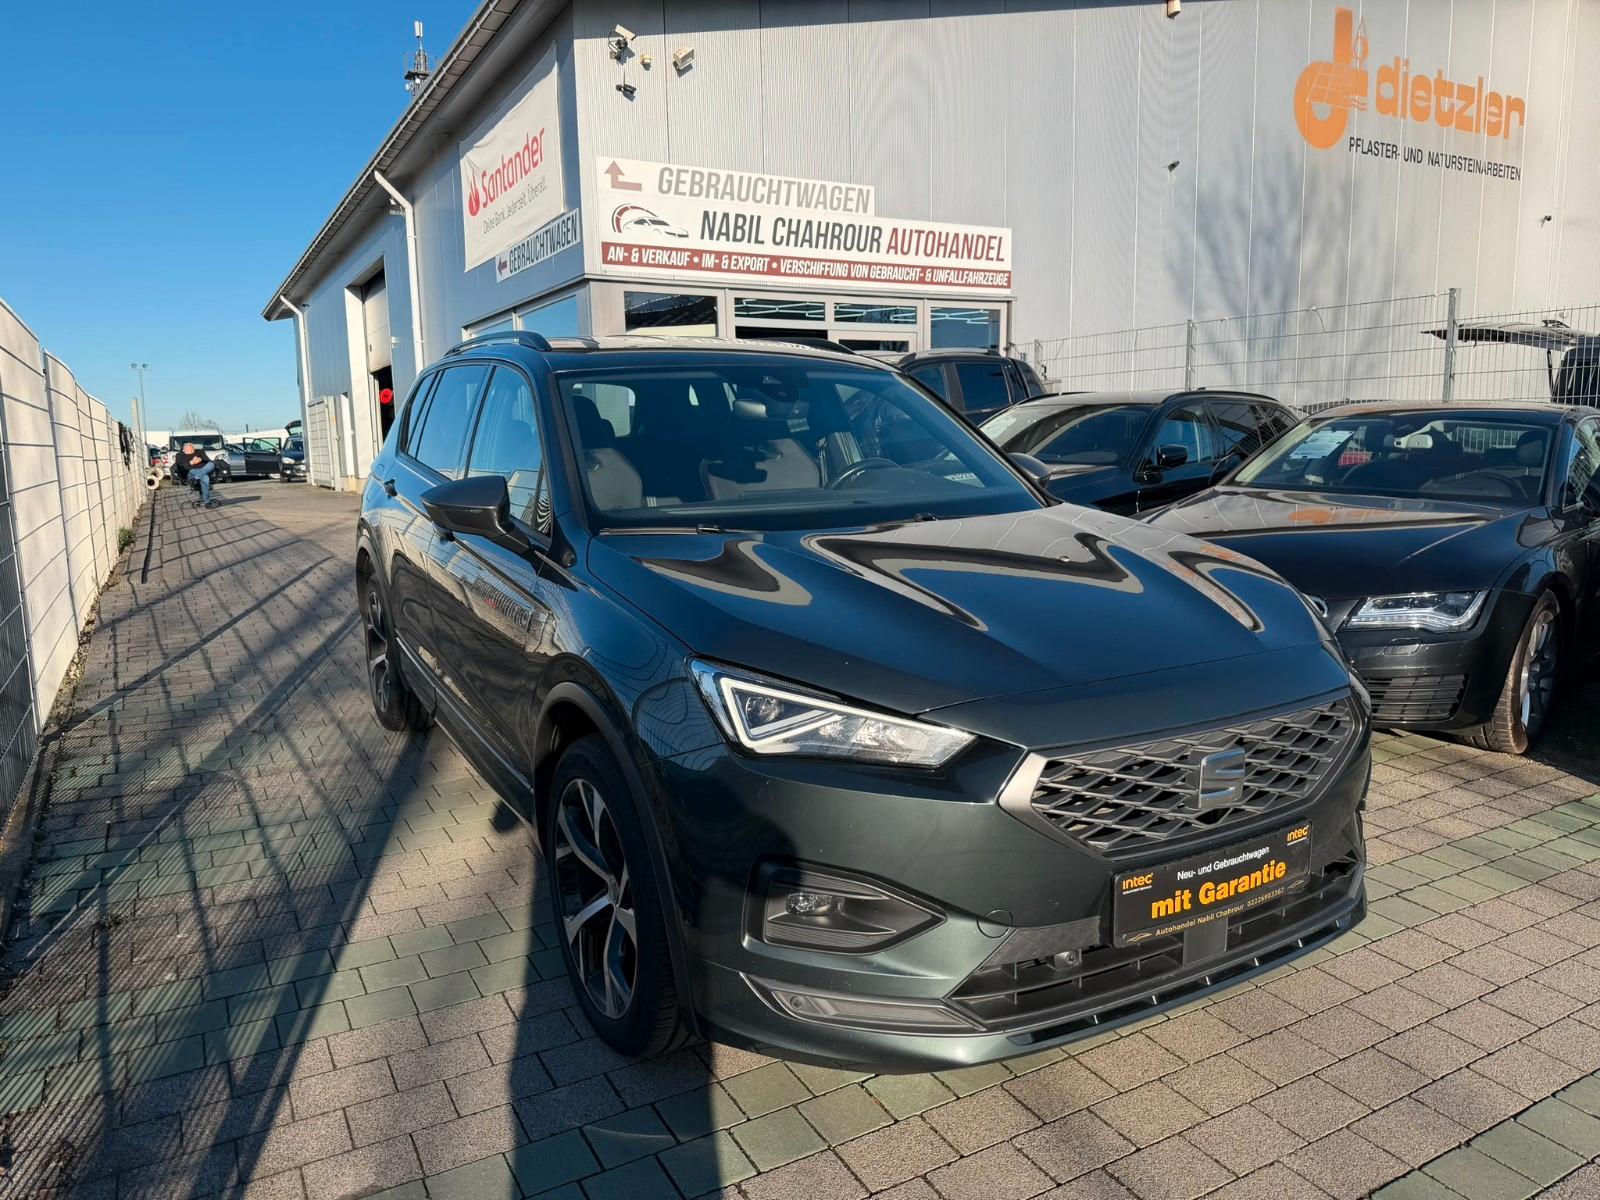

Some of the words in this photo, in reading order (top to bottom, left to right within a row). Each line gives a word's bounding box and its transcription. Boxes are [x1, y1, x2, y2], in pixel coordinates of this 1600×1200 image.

[1375, 56, 1526, 140] dietzler
[481, 127, 545, 209] Santander
[1349, 136, 1401, 160] PFLASTER-
[1403, 146, 1423, 165] UND
[1427, 152, 1521, 182] NATURSTEINARBEITEN
[657, 166, 871, 214] GEBRAUCHTWAGEN
[509, 213, 578, 274] GEBRAUCHTWAGEN
[699, 210, 765, 245] NABIL
[772, 216, 883, 254] CHAHROUR
[886, 227, 1005, 262] AUTOHANDEL
[607, 246, 629, 262] AN-
[631, 247, 639, 262] &
[641, 248, 691, 266] VERKAUF
[701, 253, 719, 268] IM-
[721, 254, 729, 268] &
[731, 254, 770, 272] EXPORT
[780, 259, 849, 278] VERSCHIFFUNG
[850, 264, 868, 278] VON
[870, 265, 923, 282] GEBRAUCHT-
[925, 268, 932, 282] &
[933, 269, 1009, 287] UNFALLFAHRZEUGE
[1287, 825, 1309, 842] intec
[1122, 873, 1154, 890] intec
[1177, 869, 1196, 881] Neu-
[1197, 863, 1212, 876] und
[1213, 846, 1270, 870] Gebrauchtwagen
[1151, 887, 1192, 919] mit
[1198, 860, 1287, 905] Garantie
[1155, 919, 1196, 937] Autohandel
[1197, 913, 1215, 927] Nabil
[1215, 904, 1245, 920] Chahrour
